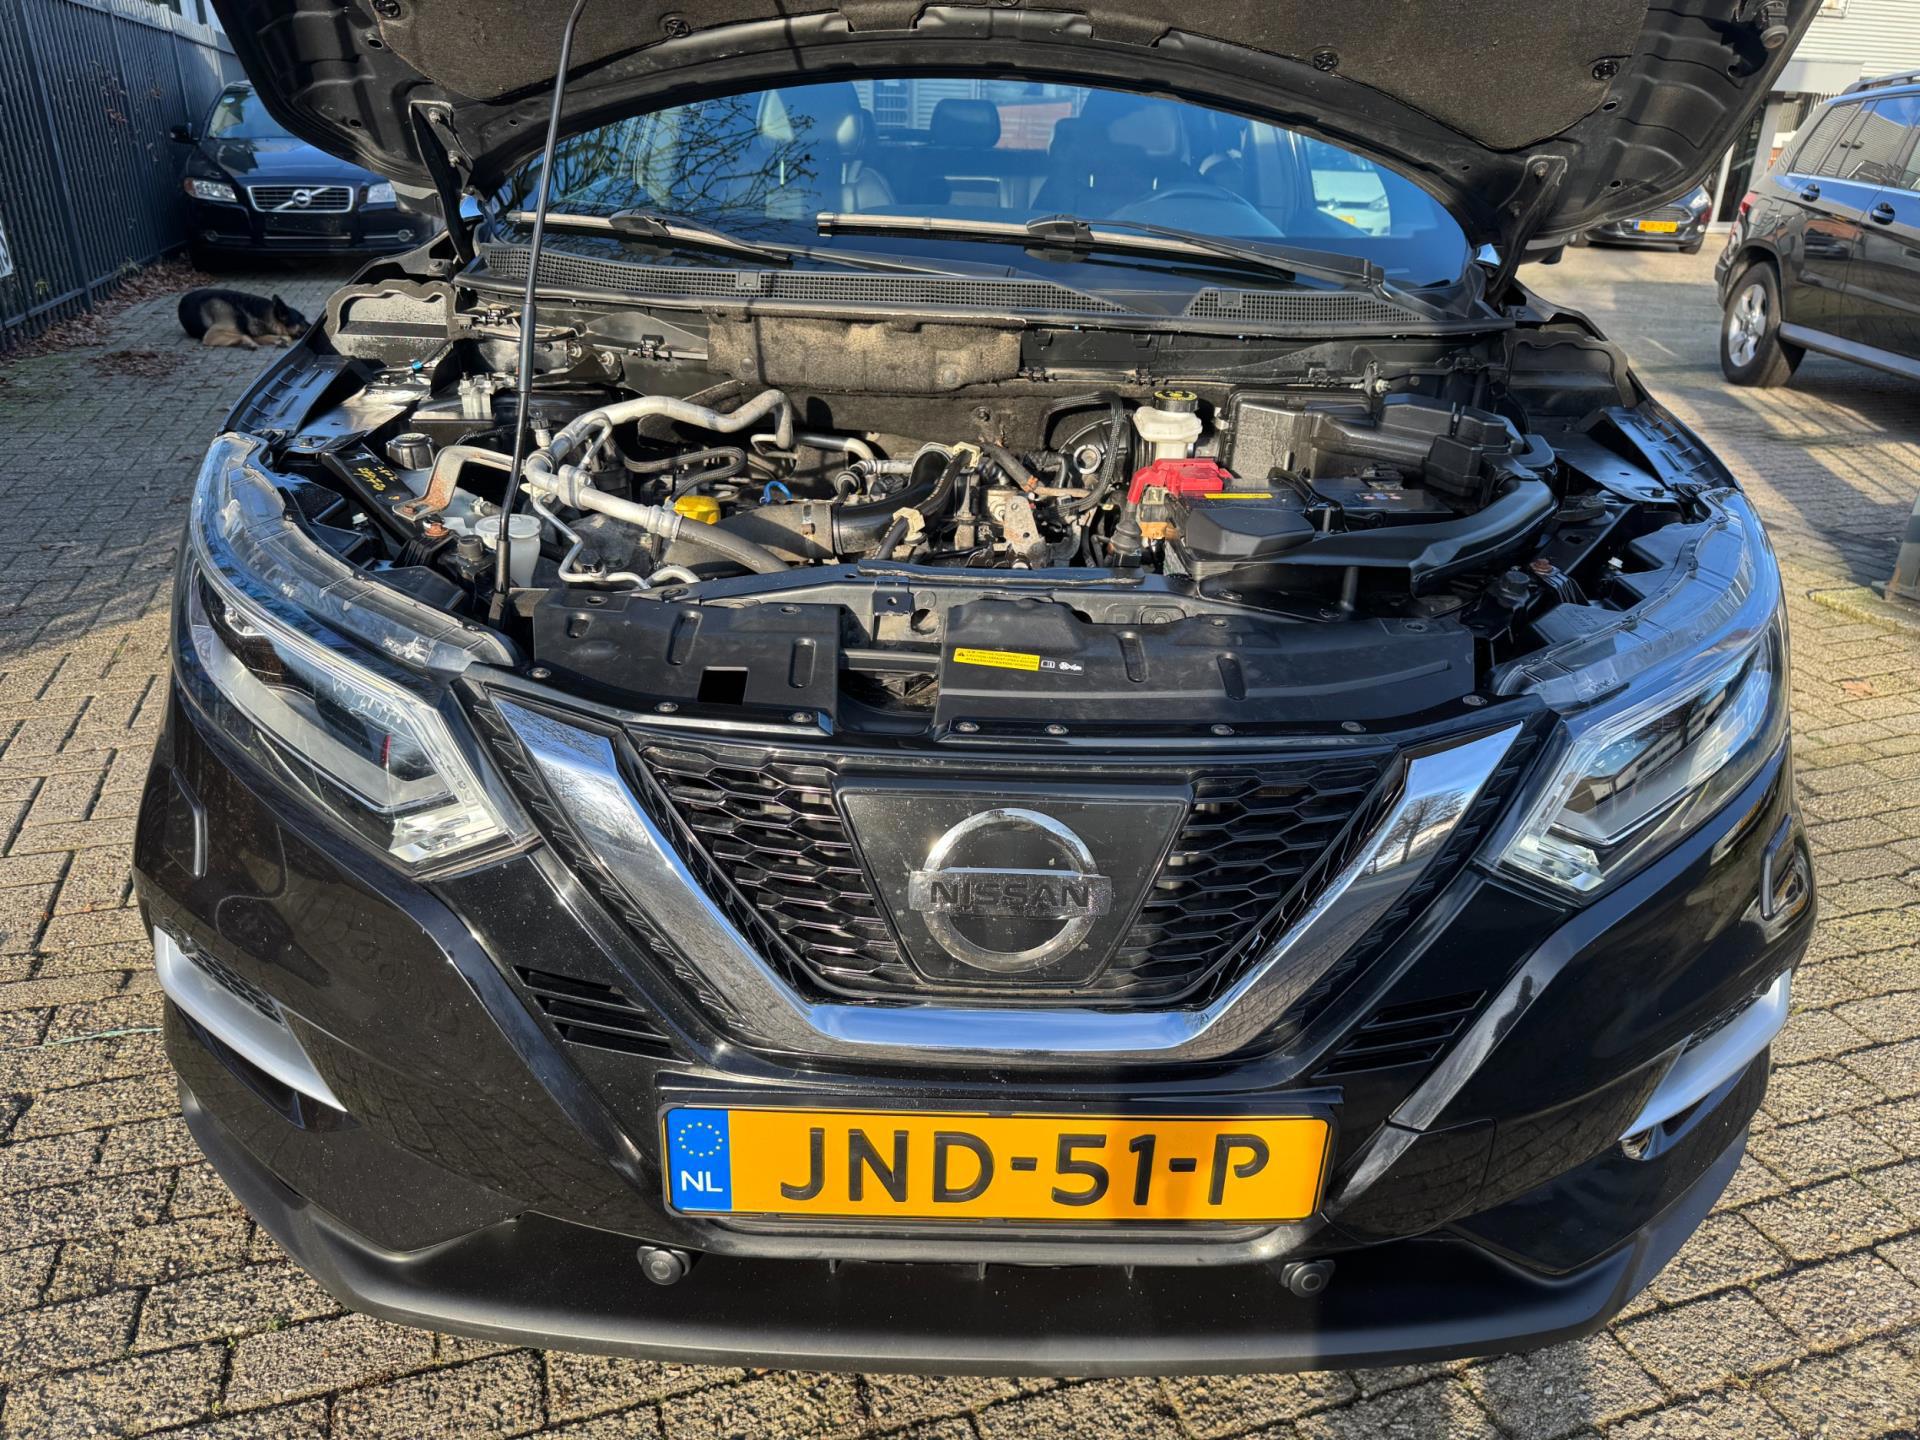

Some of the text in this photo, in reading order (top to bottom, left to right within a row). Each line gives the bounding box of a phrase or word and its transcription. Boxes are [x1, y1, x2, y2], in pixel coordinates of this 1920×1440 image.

[930, 881, 1089, 909] NISSAN
[780, 1127, 1270, 1207] JND-51-P
[681, 1170, 724, 1193] NL
